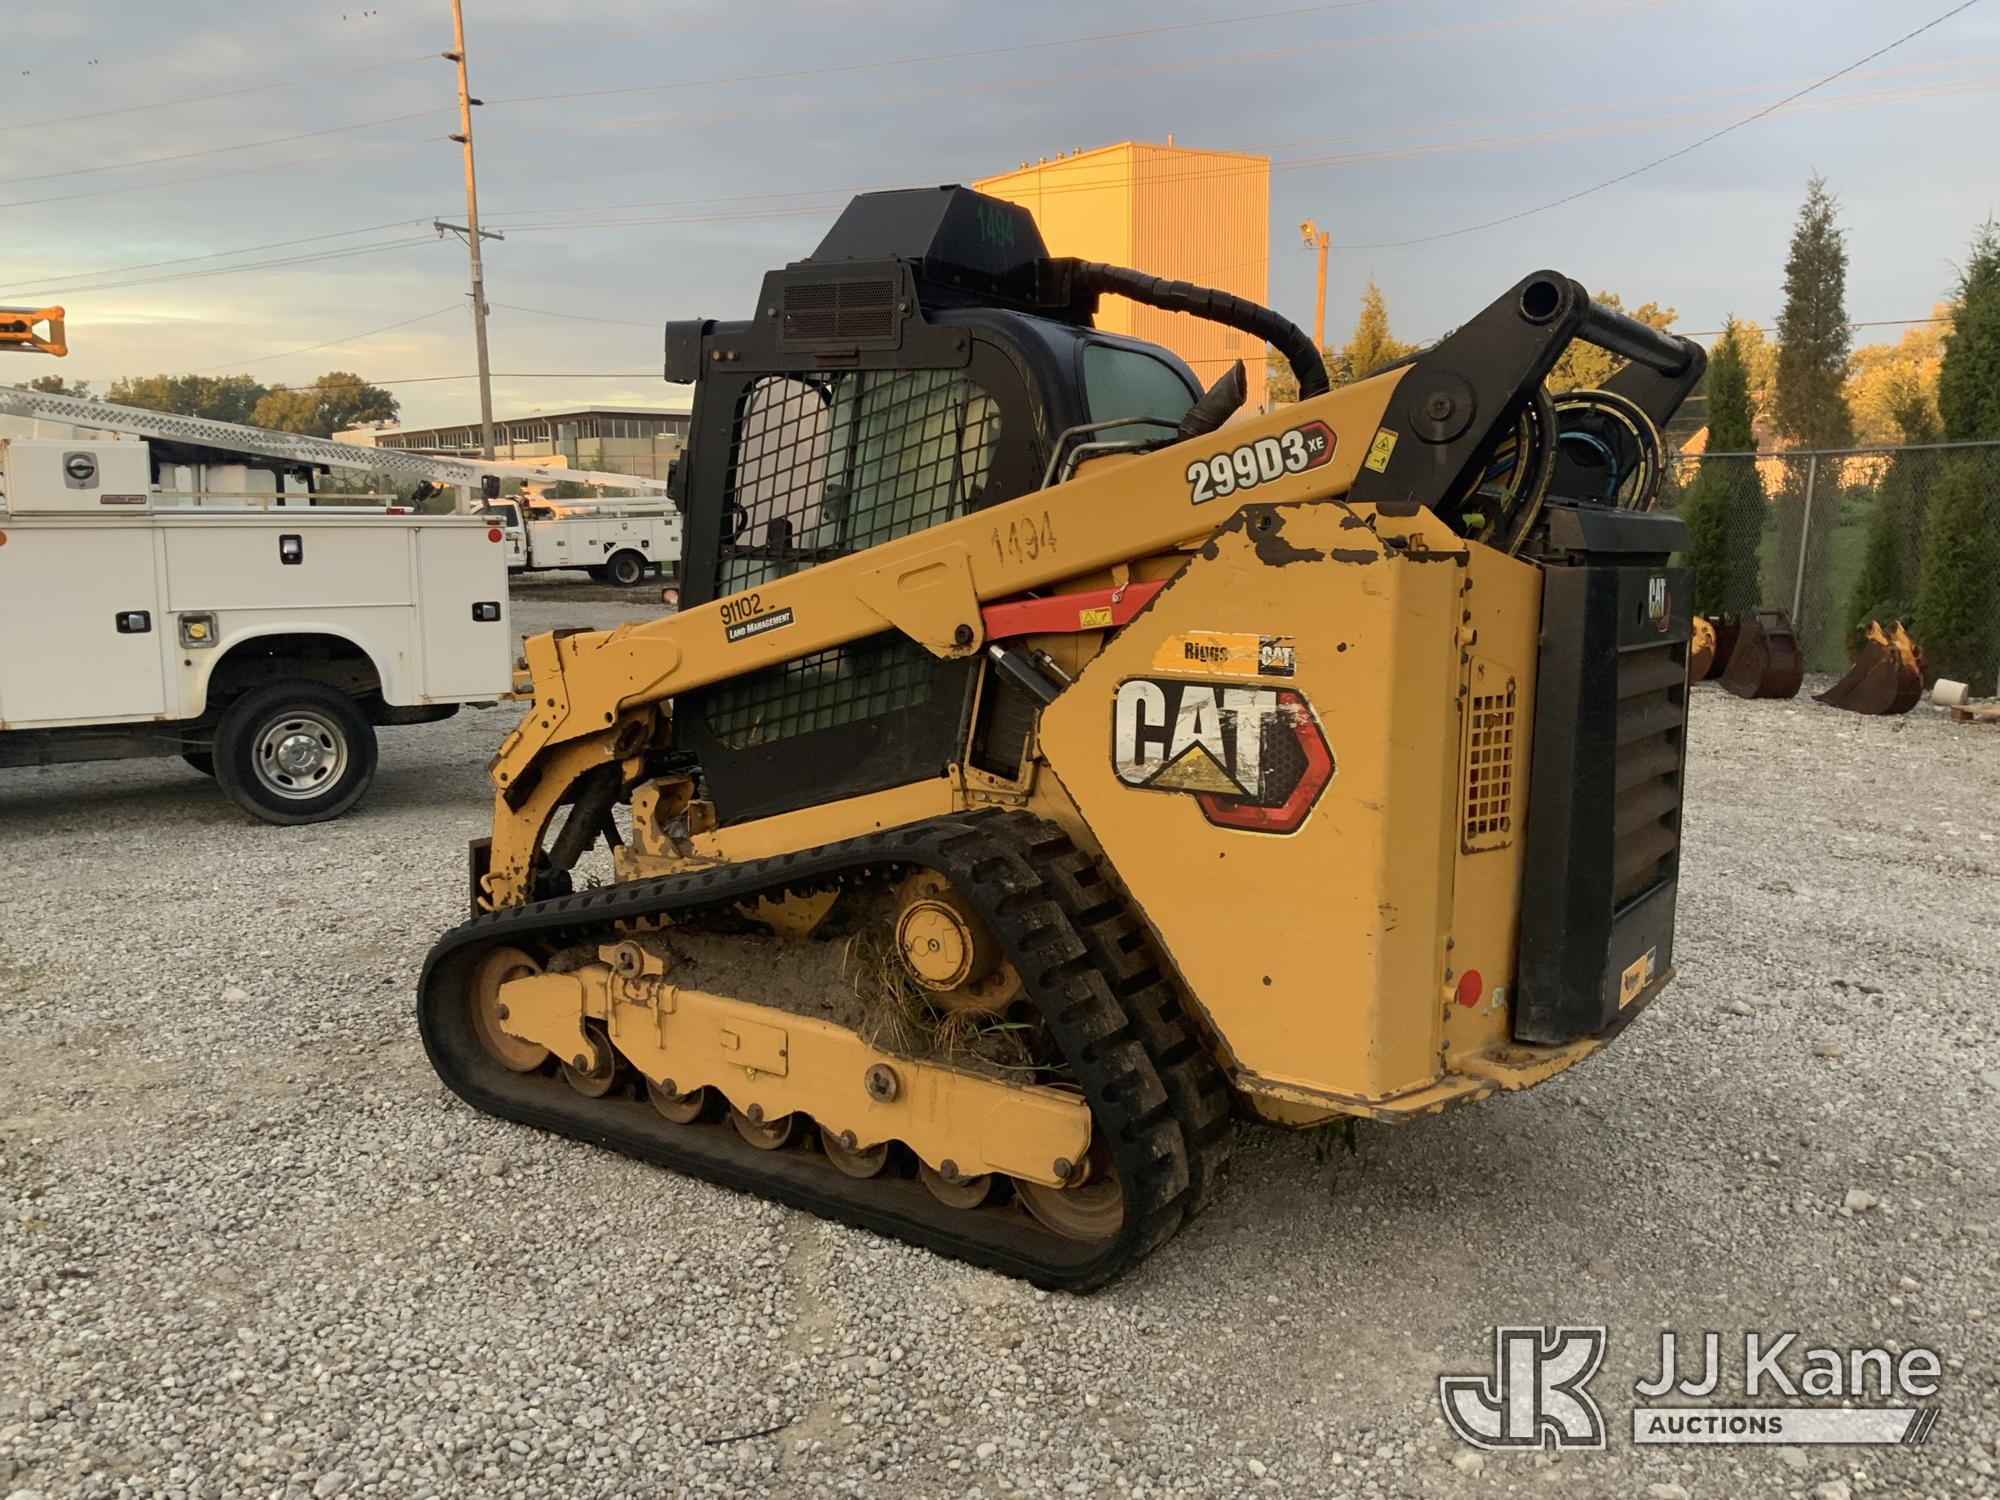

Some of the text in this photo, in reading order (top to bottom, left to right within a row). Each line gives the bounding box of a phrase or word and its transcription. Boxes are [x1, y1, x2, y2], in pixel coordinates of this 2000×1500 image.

[1187, 430, 1325, 503] 299D3 XE
[991, 510, 1057, 569] 1494
[720, 593, 764, 625] 91102
[1649, 578, 1666, 619] CAT
[1261, 646, 1292, 667] CAT
[1116, 680, 1277, 796] CAT
